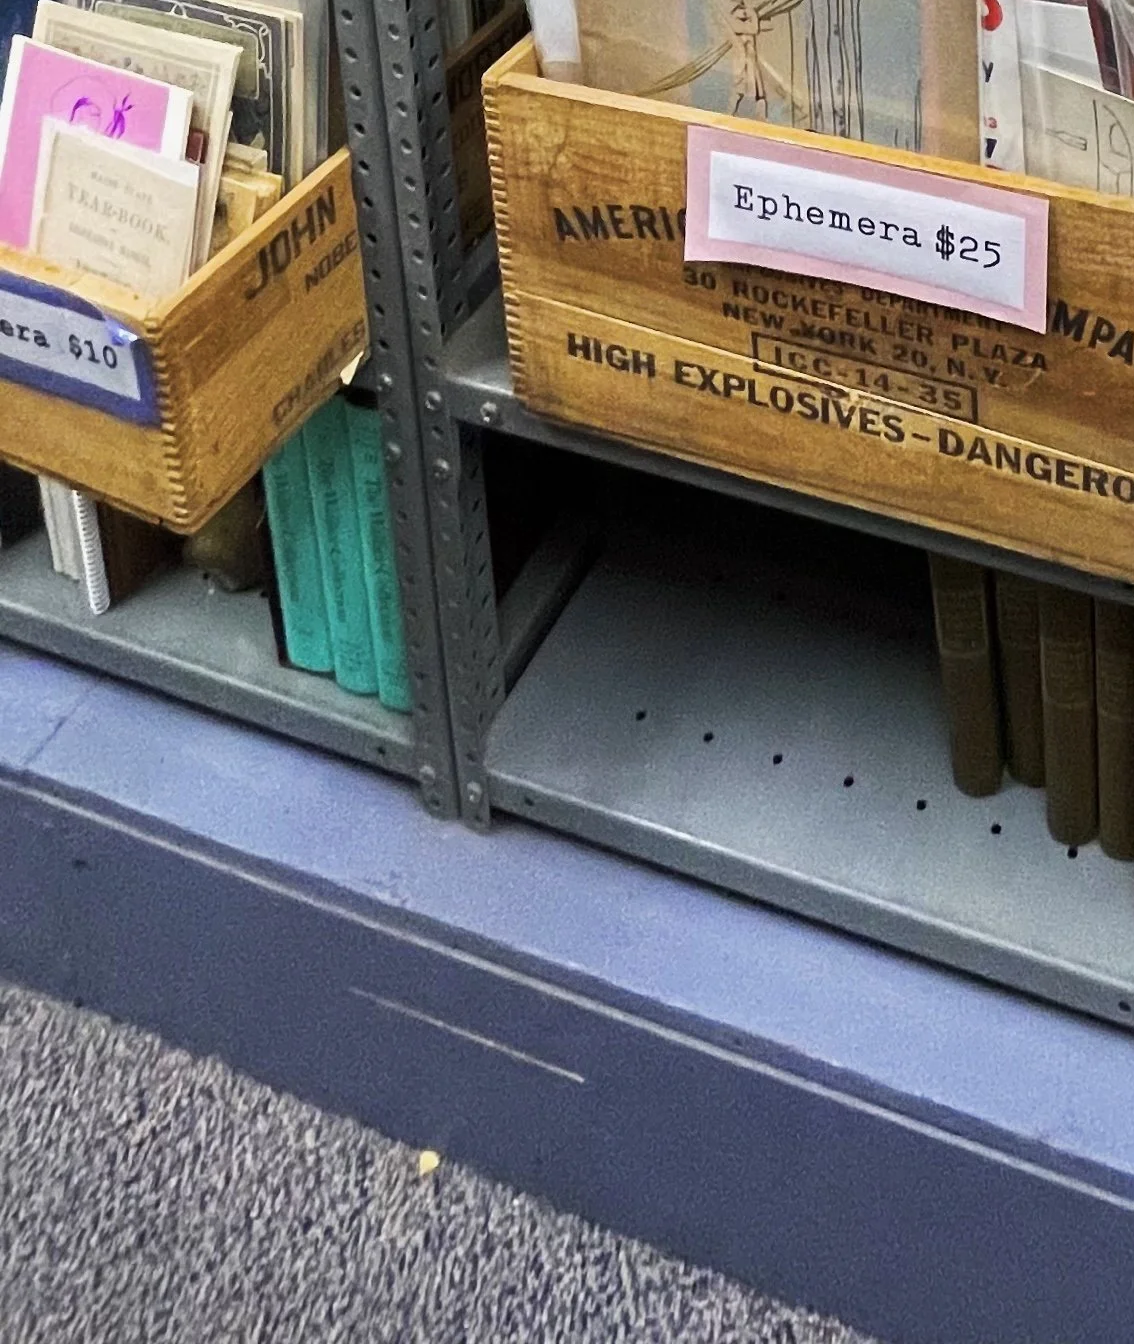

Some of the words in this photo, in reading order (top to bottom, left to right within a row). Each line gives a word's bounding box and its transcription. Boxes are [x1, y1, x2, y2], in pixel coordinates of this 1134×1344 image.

[244, 185, 337, 301] JOHN
[733, 183, 922, 249] Ephemera
[935, 224, 1003, 270] $25
[68, 333, 119, 370] $10
[683, 269, 717, 292] 30
[732, 279, 934, 346] ROCKEFELLER
[951, 332, 1048, 371] PLAZA
[721, 301, 785, 330] NEW
[798, 322, 877, 355] YORK
[566, 332, 657, 379] HIGH
